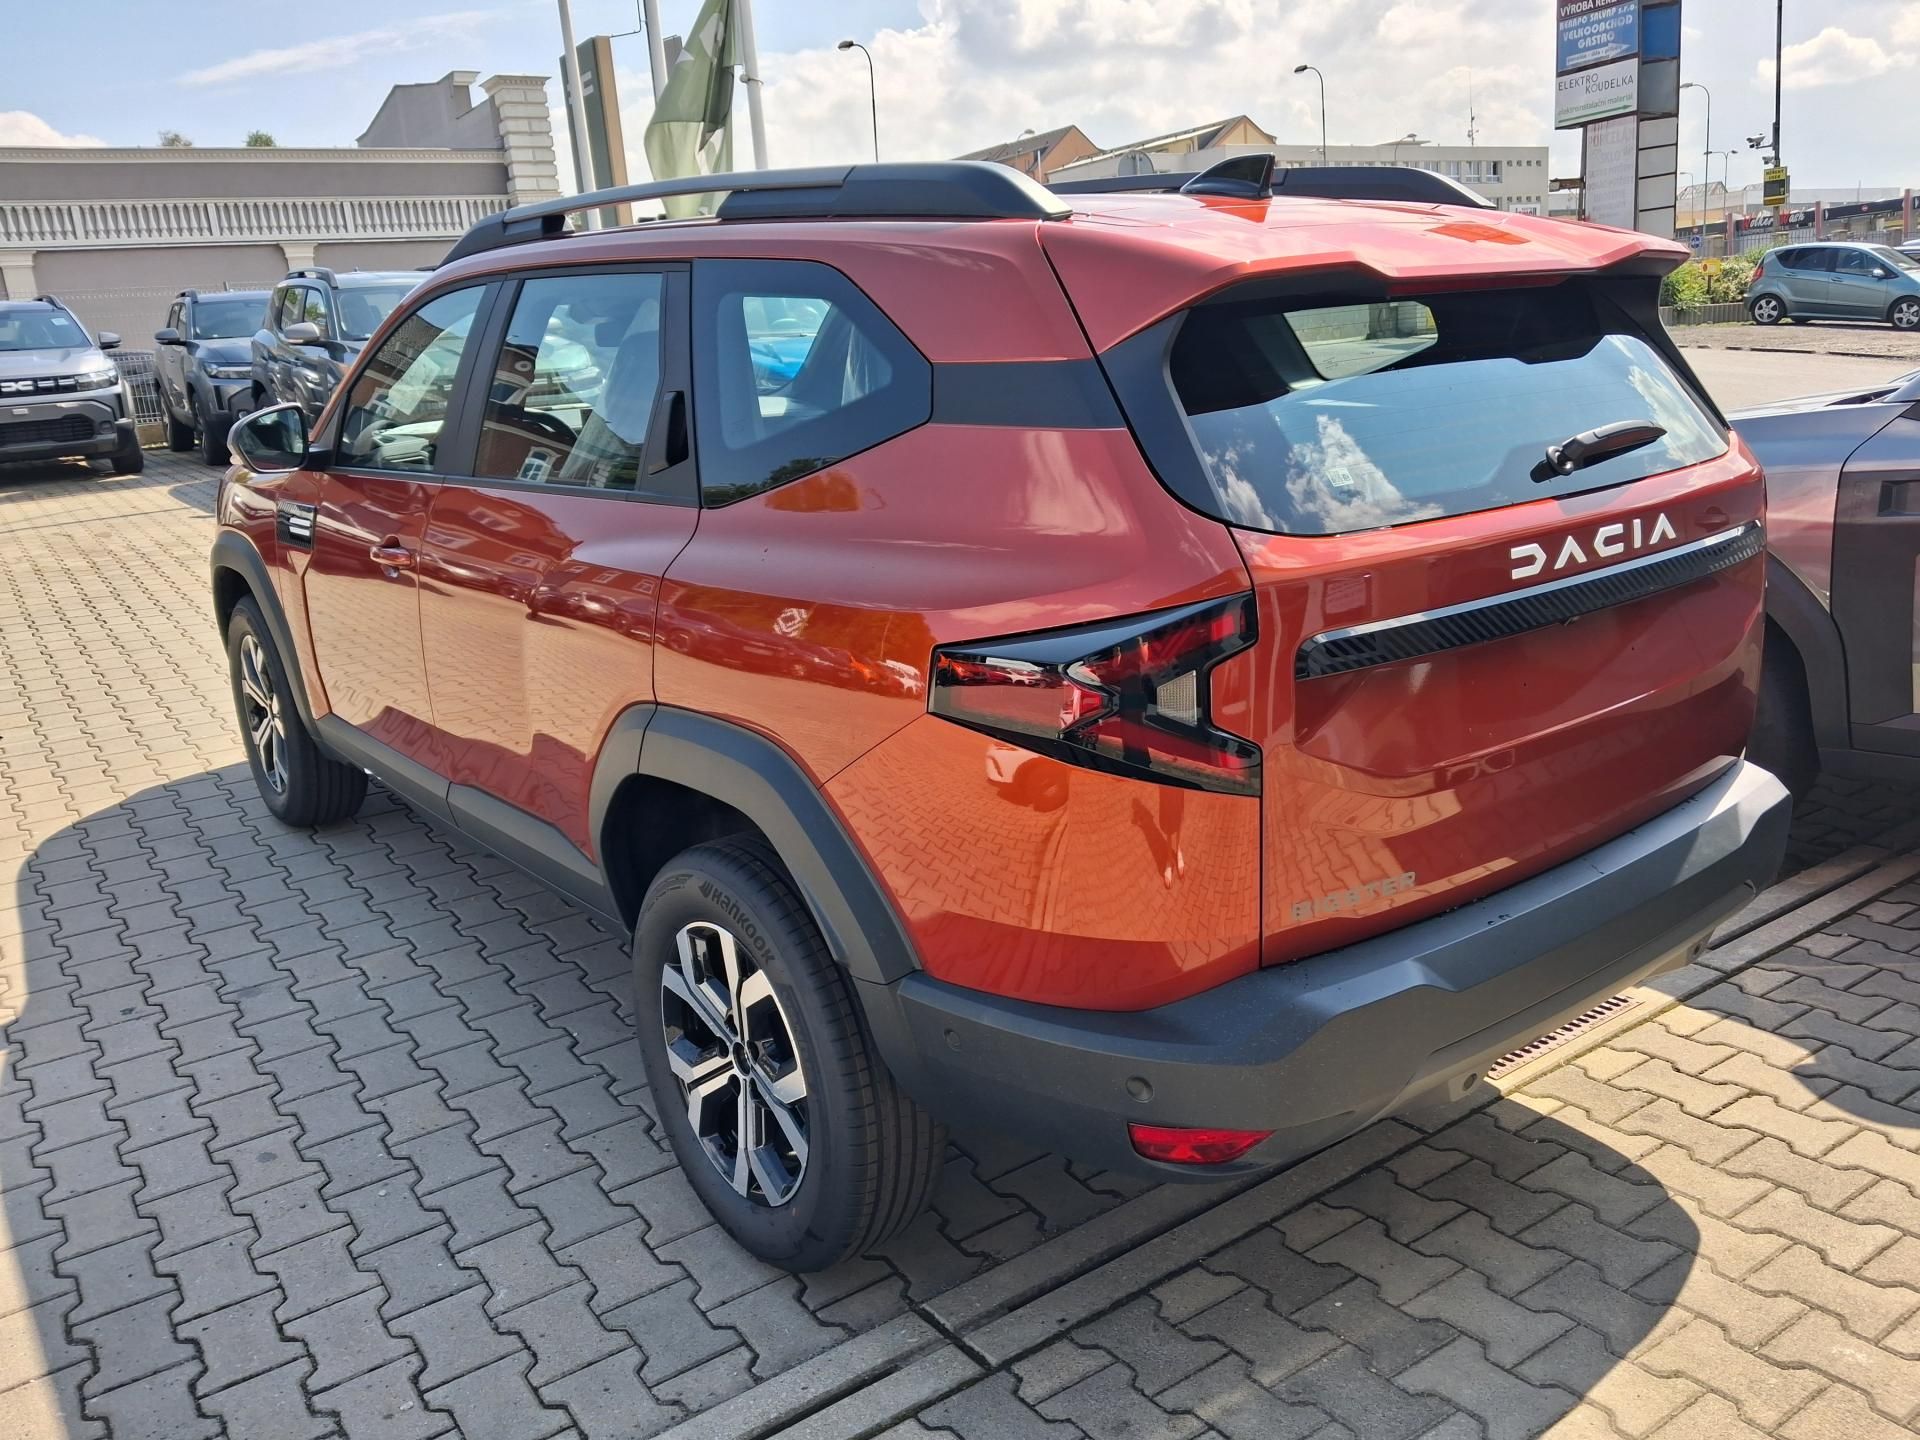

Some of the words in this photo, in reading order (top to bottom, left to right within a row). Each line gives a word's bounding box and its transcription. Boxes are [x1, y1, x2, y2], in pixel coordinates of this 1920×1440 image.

[1563, 15, 1633, 41] VELKOOBCHOD
[1577, 31, 1616, 49] GASTRO
[1558, 73, 1599, 91] ELEKTRO
[1585, 74, 1634, 94] KOUDELKA
[1510, 512, 1677, 580] DACIA
